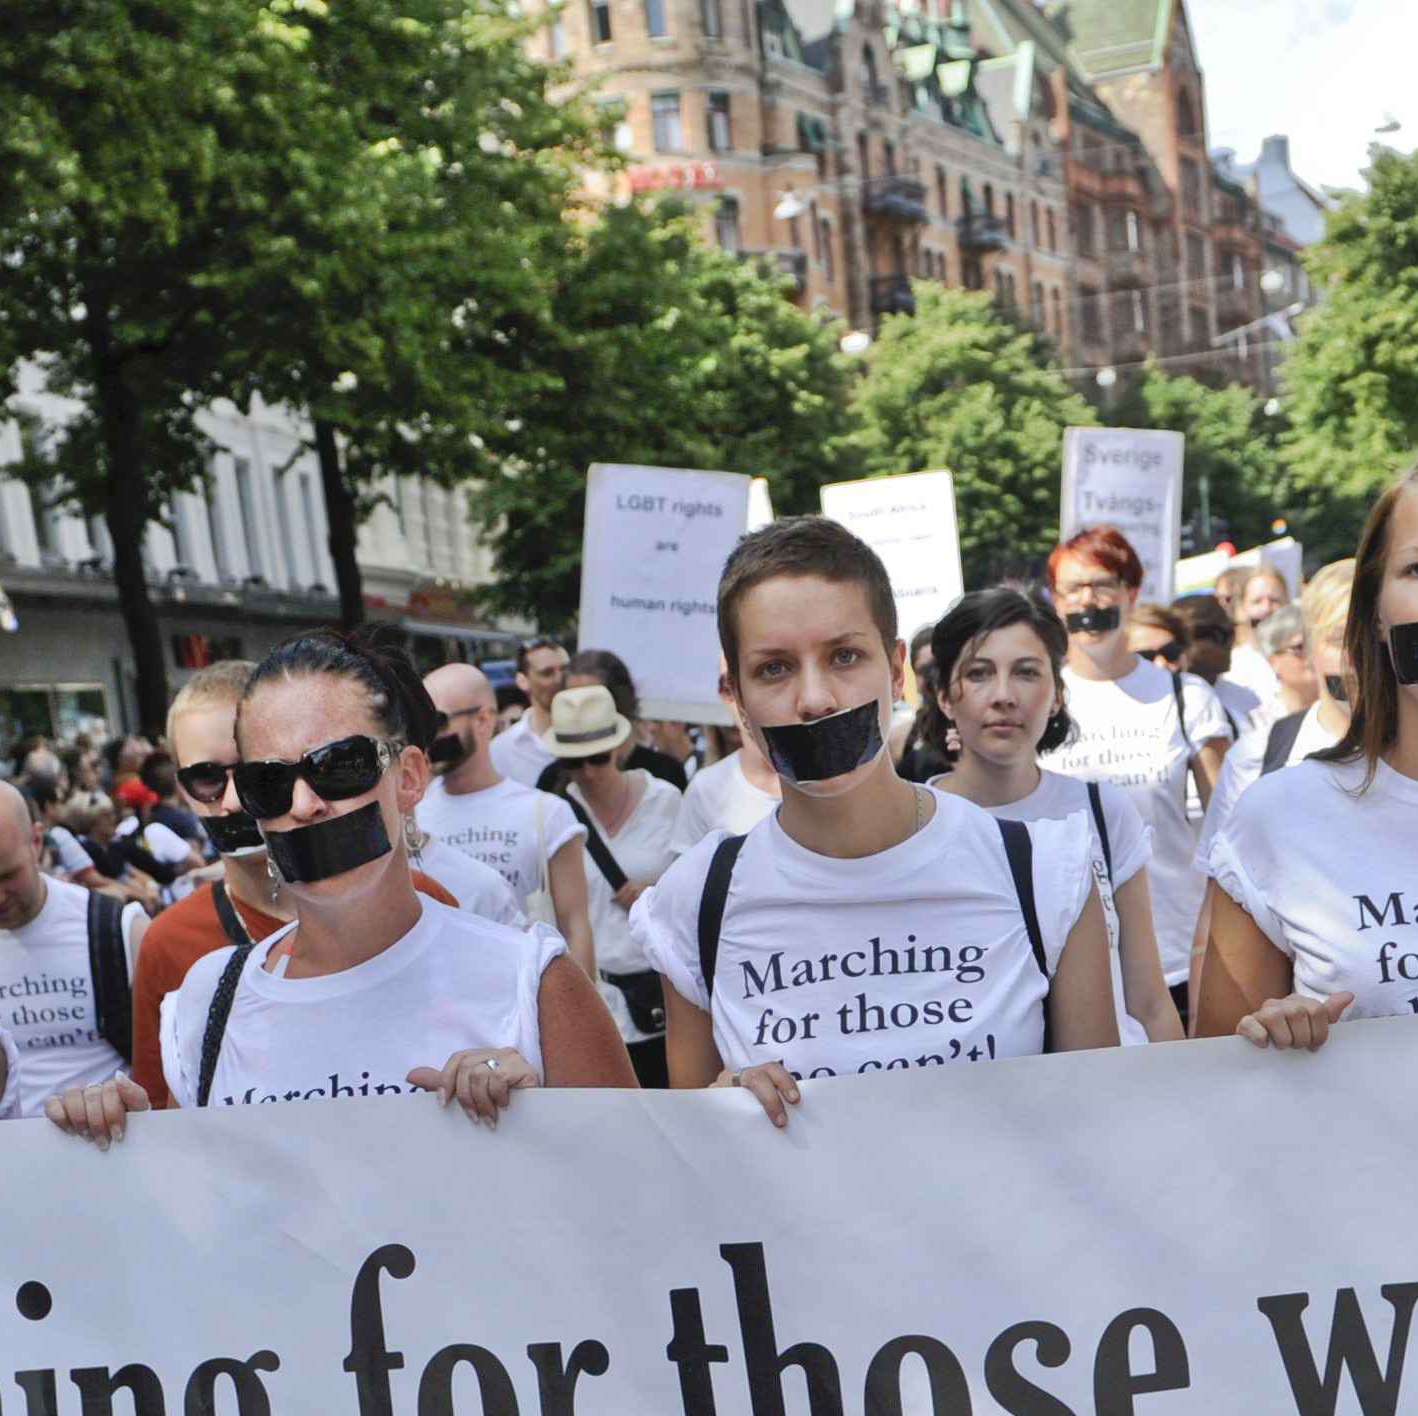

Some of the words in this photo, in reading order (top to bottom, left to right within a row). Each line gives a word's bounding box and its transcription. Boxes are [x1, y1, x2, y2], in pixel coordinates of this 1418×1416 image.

[1084, 443, 1163, 469] Sverige
[617, 495, 666, 511] LGBT
[672, 499, 723, 518] rights
[656, 541, 679, 551] are
[611, 595, 665, 611] human
[670, 600, 716, 615] rights
[1079, 726, 1161, 742] arching
[1062, 754, 1089, 769] for
[440, 825, 519, 847] rching
[739, 934, 988, 999] Marching
[12, 1004, 85, 1025] those
[753, 1009, 820, 1046] for
[836, 992, 973, 1034] those
